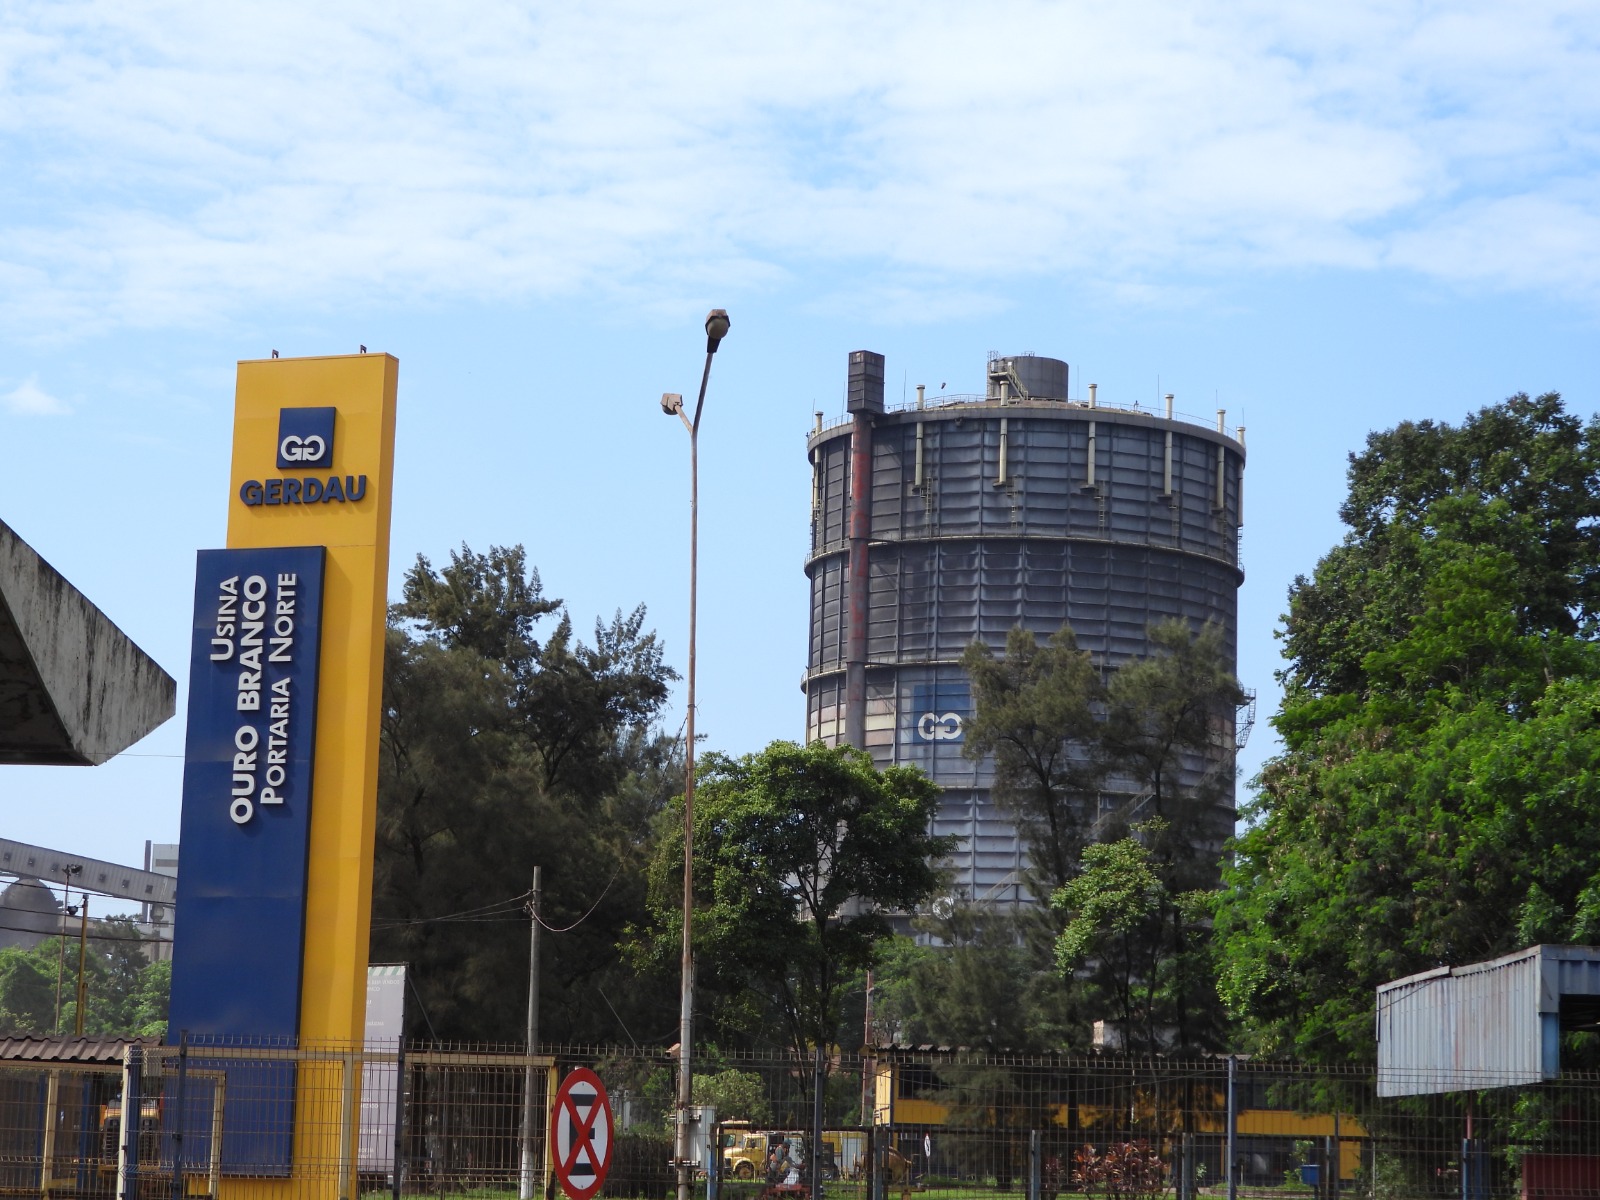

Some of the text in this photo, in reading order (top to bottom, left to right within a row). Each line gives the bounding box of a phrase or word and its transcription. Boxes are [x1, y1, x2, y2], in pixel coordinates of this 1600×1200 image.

[239, 474, 367, 506] GERDAU
[210, 575, 240, 661] USINA
[260, 573, 297, 804] PORTARIA NORTE
[229, 574, 267, 825] OURO BRANCO
